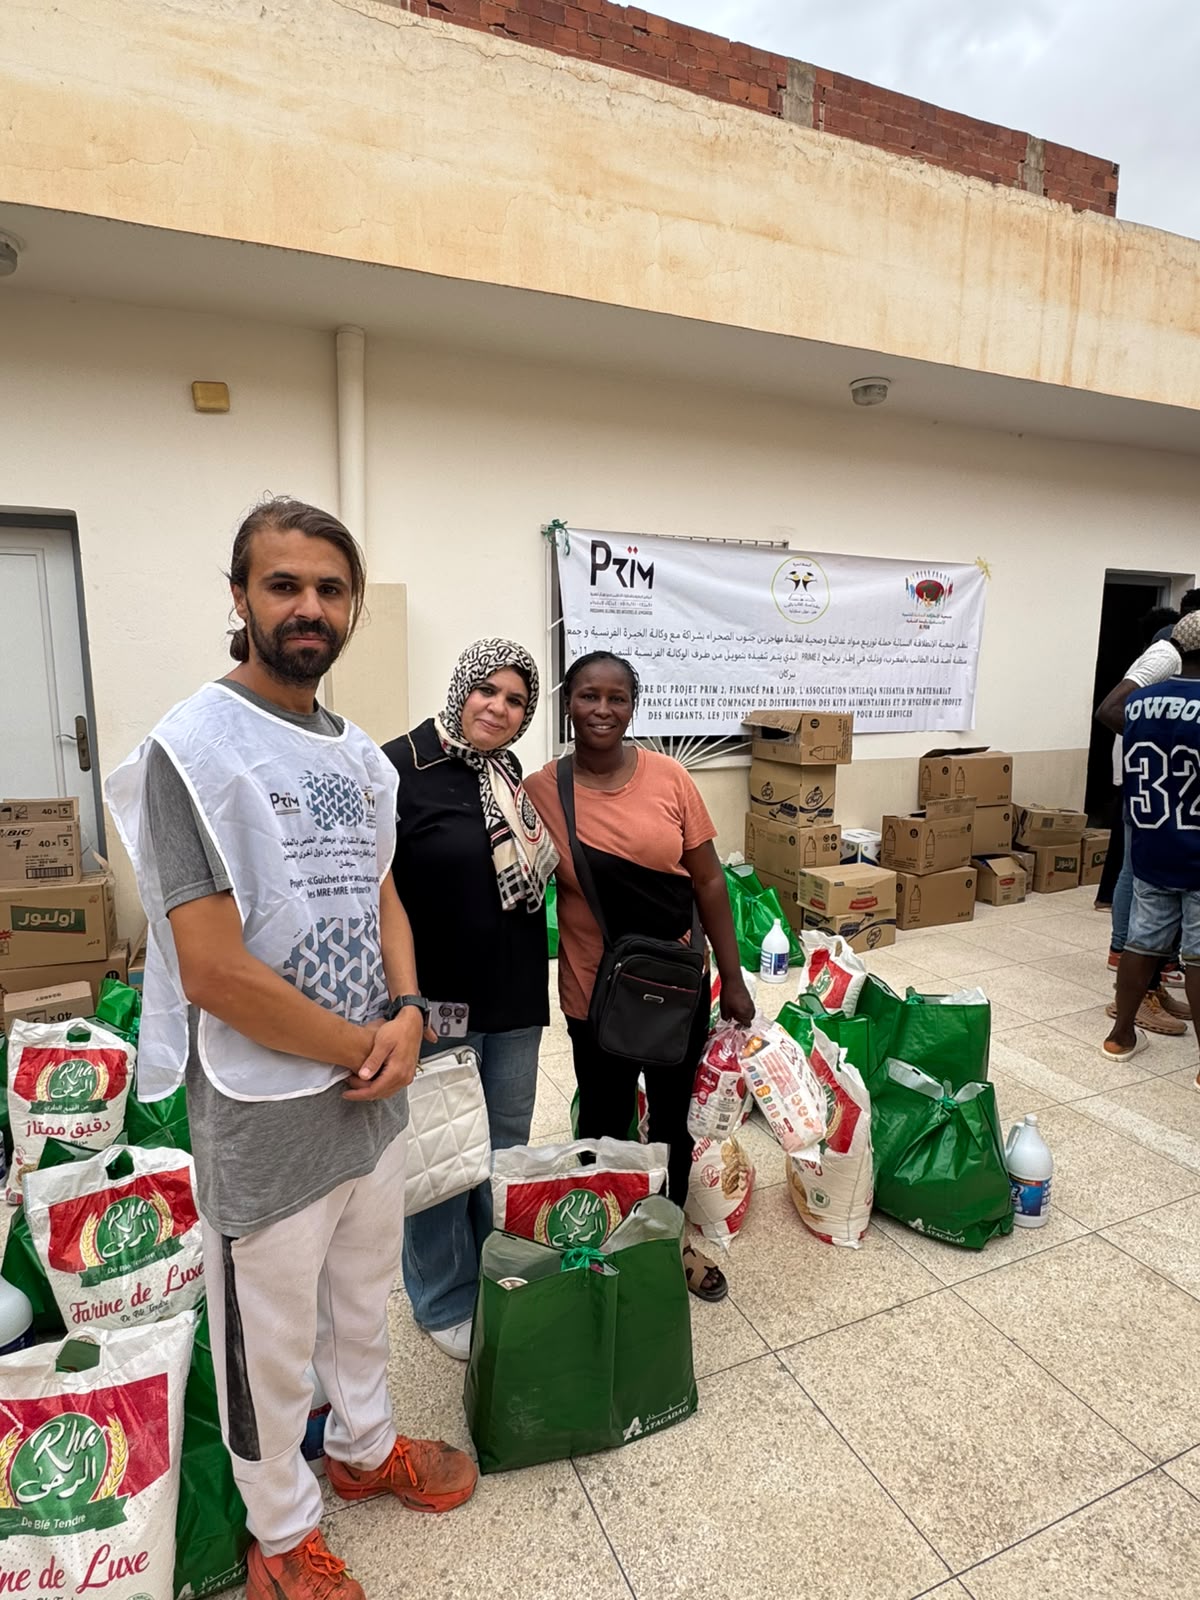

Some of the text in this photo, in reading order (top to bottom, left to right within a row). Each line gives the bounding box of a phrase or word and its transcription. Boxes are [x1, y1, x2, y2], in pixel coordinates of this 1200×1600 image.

[656, 685, 667, 694] DU
[670, 685, 697, 695] PROJET
[700, 685, 718, 694] PRIM
[729, 684, 759, 694] FINANCÉ
[762, 686, 774, 694] PAR
[799, 686, 847, 695] L'ASSOCIATION
[907, 687, 914, 695] EN
[916, 687, 951, 695] PARTENARIAT
[643, 698, 671, 707] FRANCE
[674, 698, 697, 707] LANCE
[700, 698, 715, 707] UNE
[717, 698, 755, 707] COMPAGNE
[758, 699, 766, 707] DE
[769, 699, 816, 707] DISTRIBUTION
[819, 699, 830, 707] DES
[832, 699, 846, 707] KITS
[848, 698, 891, 707] ALIMENTAIRES
[893, 698, 900, 706] ET
[942, 698, 962, 706] PROFIT
[1125, 697, 1200, 724] OWBO
[648, 711, 662, 720] DES
[722, 711, 738, 721] JUIN
[856, 710, 873, 719] POUR
[874, 710, 884, 718] LES
[886, 710, 913, 718] SERVICES
[1124, 741, 1200, 830] 32
[317, 886, 349, 897] MRE-MRE
[26, 1118, 111, 1138] دقيق ممتاز
[70, 1262, 205, 1324] Farine de Luxe
[643, 1405, 689, 1433] ATACADAO
[21, 1513, 86, 1530] De Blé Tendre
[39, 1555, 66, 1589] de
[76, 1544, 150, 1594] Luxe
